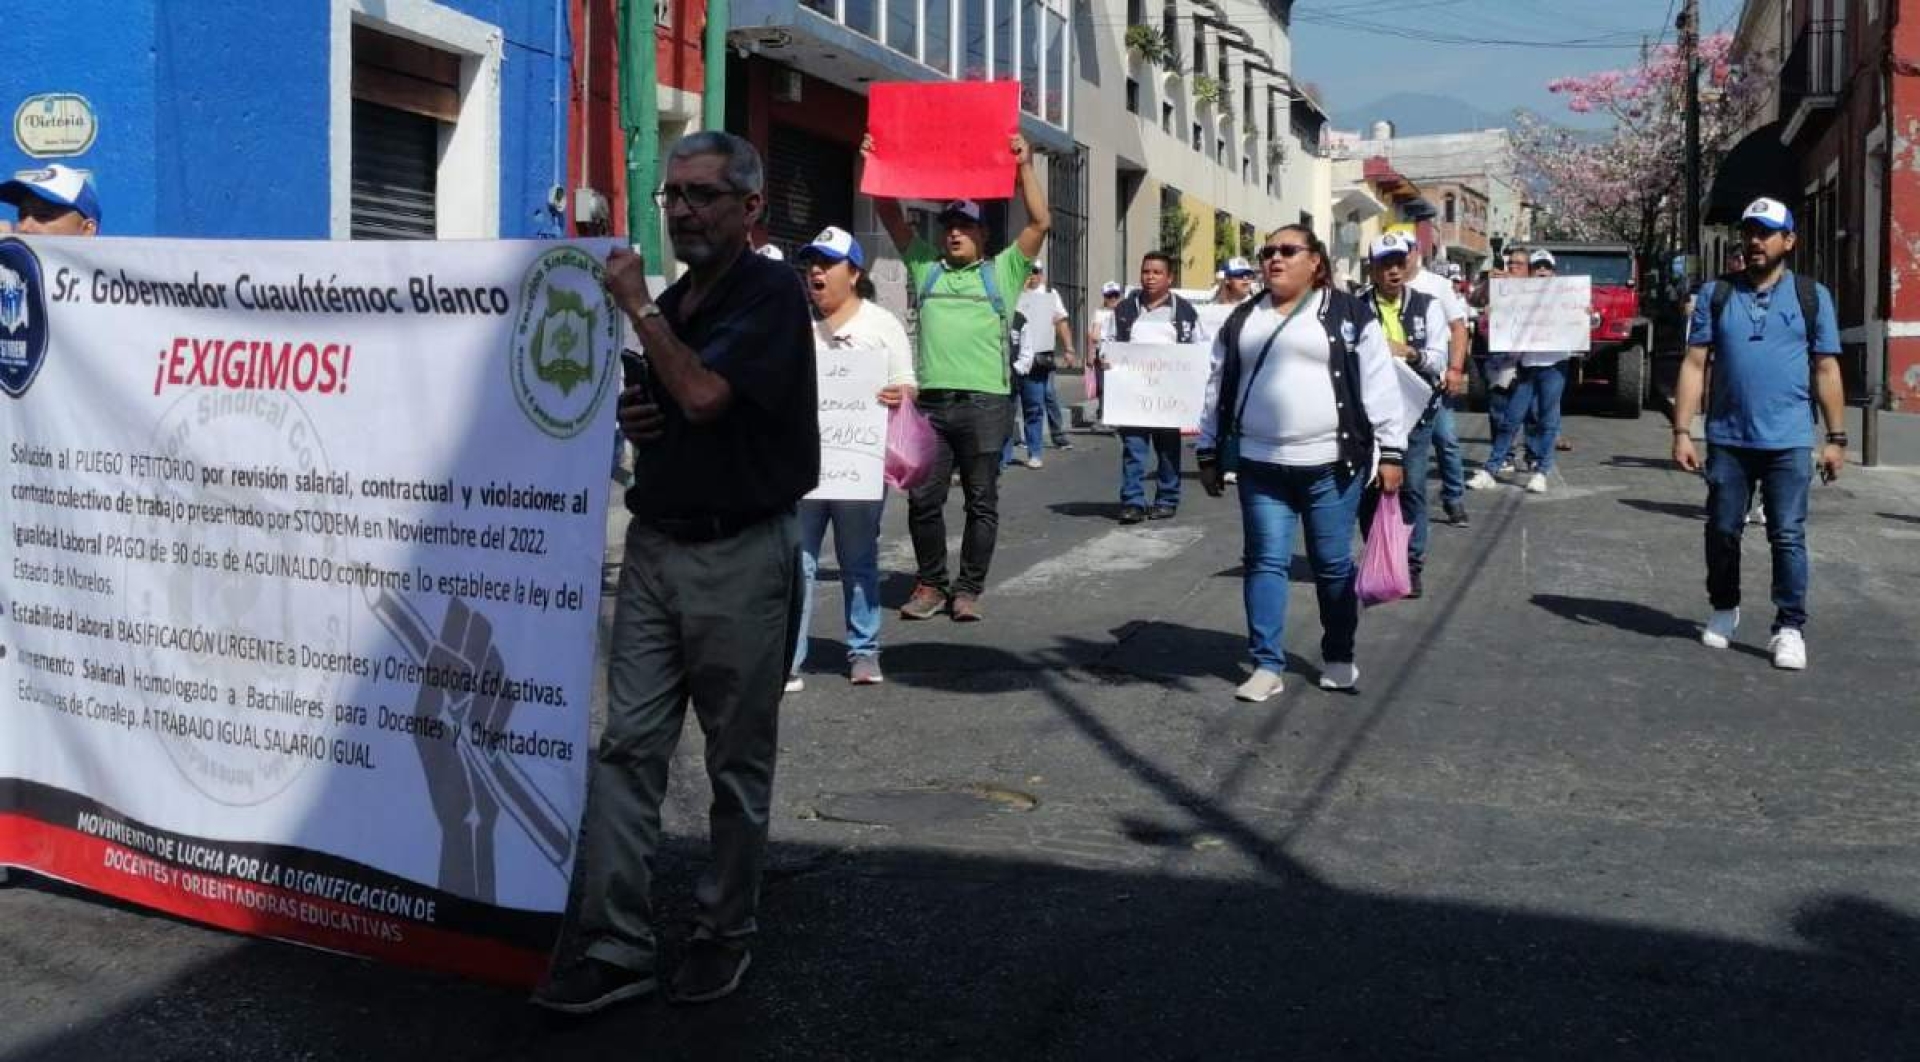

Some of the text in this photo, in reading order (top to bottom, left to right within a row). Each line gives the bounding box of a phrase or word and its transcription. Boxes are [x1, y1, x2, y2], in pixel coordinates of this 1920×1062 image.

[25, 114, 84, 129] Victoria
[52, 267, 509, 316] Sr. Gobernador Cuauhtémoc Blanco
[153, 337, 352, 396] ¡EXIGIMOS!
[11, 442, 588, 515] Solución al PLIEGO PETITORIO por revisión salarial, contractual y violaciones al
[11, 482, 547, 554] contrato colectivo de trabajo presentado por STODEM en Noviembre del 2022.
[12, 558, 114, 596] Estado de Morelos.
[13, 523, 57, 548] Igualdad
[106, 535, 145, 559] PAGO
[150, 539, 168, 563] de
[171, 541, 188, 564] 90
[222, 548, 239, 572] de
[244, 551, 332, 582] AGUINALDO
[336, 561, 411, 592] conforme
[417, 566, 433, 593] lo
[437, 572, 510, 603] establece
[514, 576, 525, 600] la
[527, 577, 551, 610] ley
[555, 583, 583, 610] del
[11, 601, 73, 631] Estabilidad
[117, 620, 215, 653] BASIFICACIÓN
[218, 632, 284, 665] URGENTE
[287, 648, 296, 665] a
[301, 645, 369, 677] Docentes
[373, 660, 381, 684] y
[385, 656, 478, 693] Orientadoras
[480, 669, 568, 707] Educativas.
[70, 692, 83, 715] de
[86, 696, 139, 731] Conalep.
[142, 707, 151, 727] A
[154, 708, 214, 741] TRABAJO
[217, 724, 260, 749] IGUAL
[263, 728, 327, 761] SALARIO
[82, 659, 126, 687] Salarial
[133, 671, 218, 703] Homologado
[228, 688, 236, 704] a
[247, 685, 324, 719] Bachilleres
[335, 703, 367, 726] para
[377, 705, 444, 740] Docentes
[452, 725, 462, 748] y
[471, 719, 574, 762] Orientadoras
[77, 811, 436, 922] MOVIMIENTO DE LUCHA POR LA DIGNIFICACIÓN DE
[103, 847, 403, 942] DOCENTES Y ORIENTADORAS EDUCATIVAS
